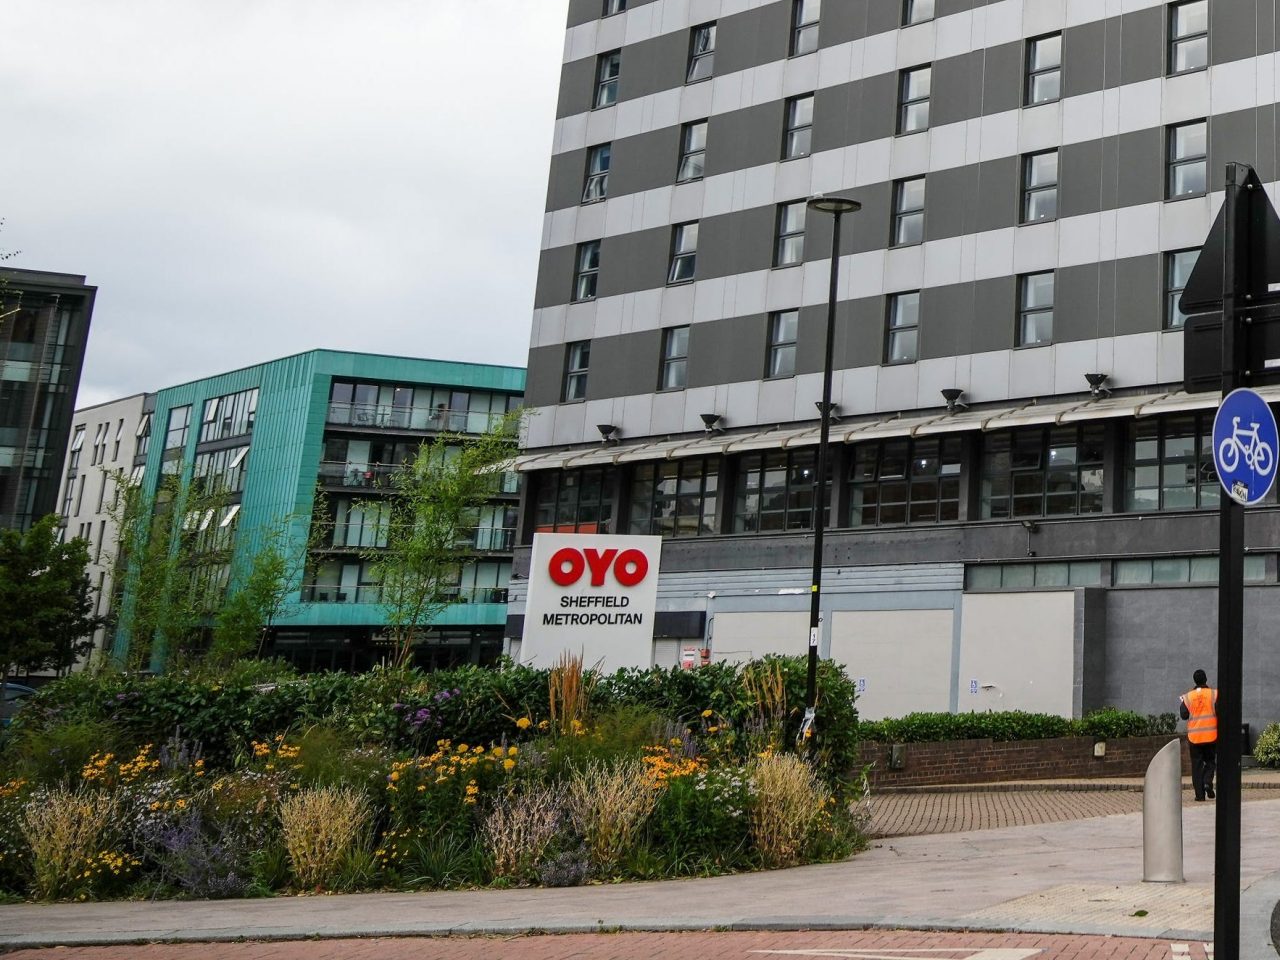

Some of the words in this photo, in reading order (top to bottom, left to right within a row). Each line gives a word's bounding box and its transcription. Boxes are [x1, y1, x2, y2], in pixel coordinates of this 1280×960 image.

[548, 547, 649, 587] OYO
[560, 596, 630, 608] SHEFFIELD
[542, 613, 643, 626] METROPOLITAN
